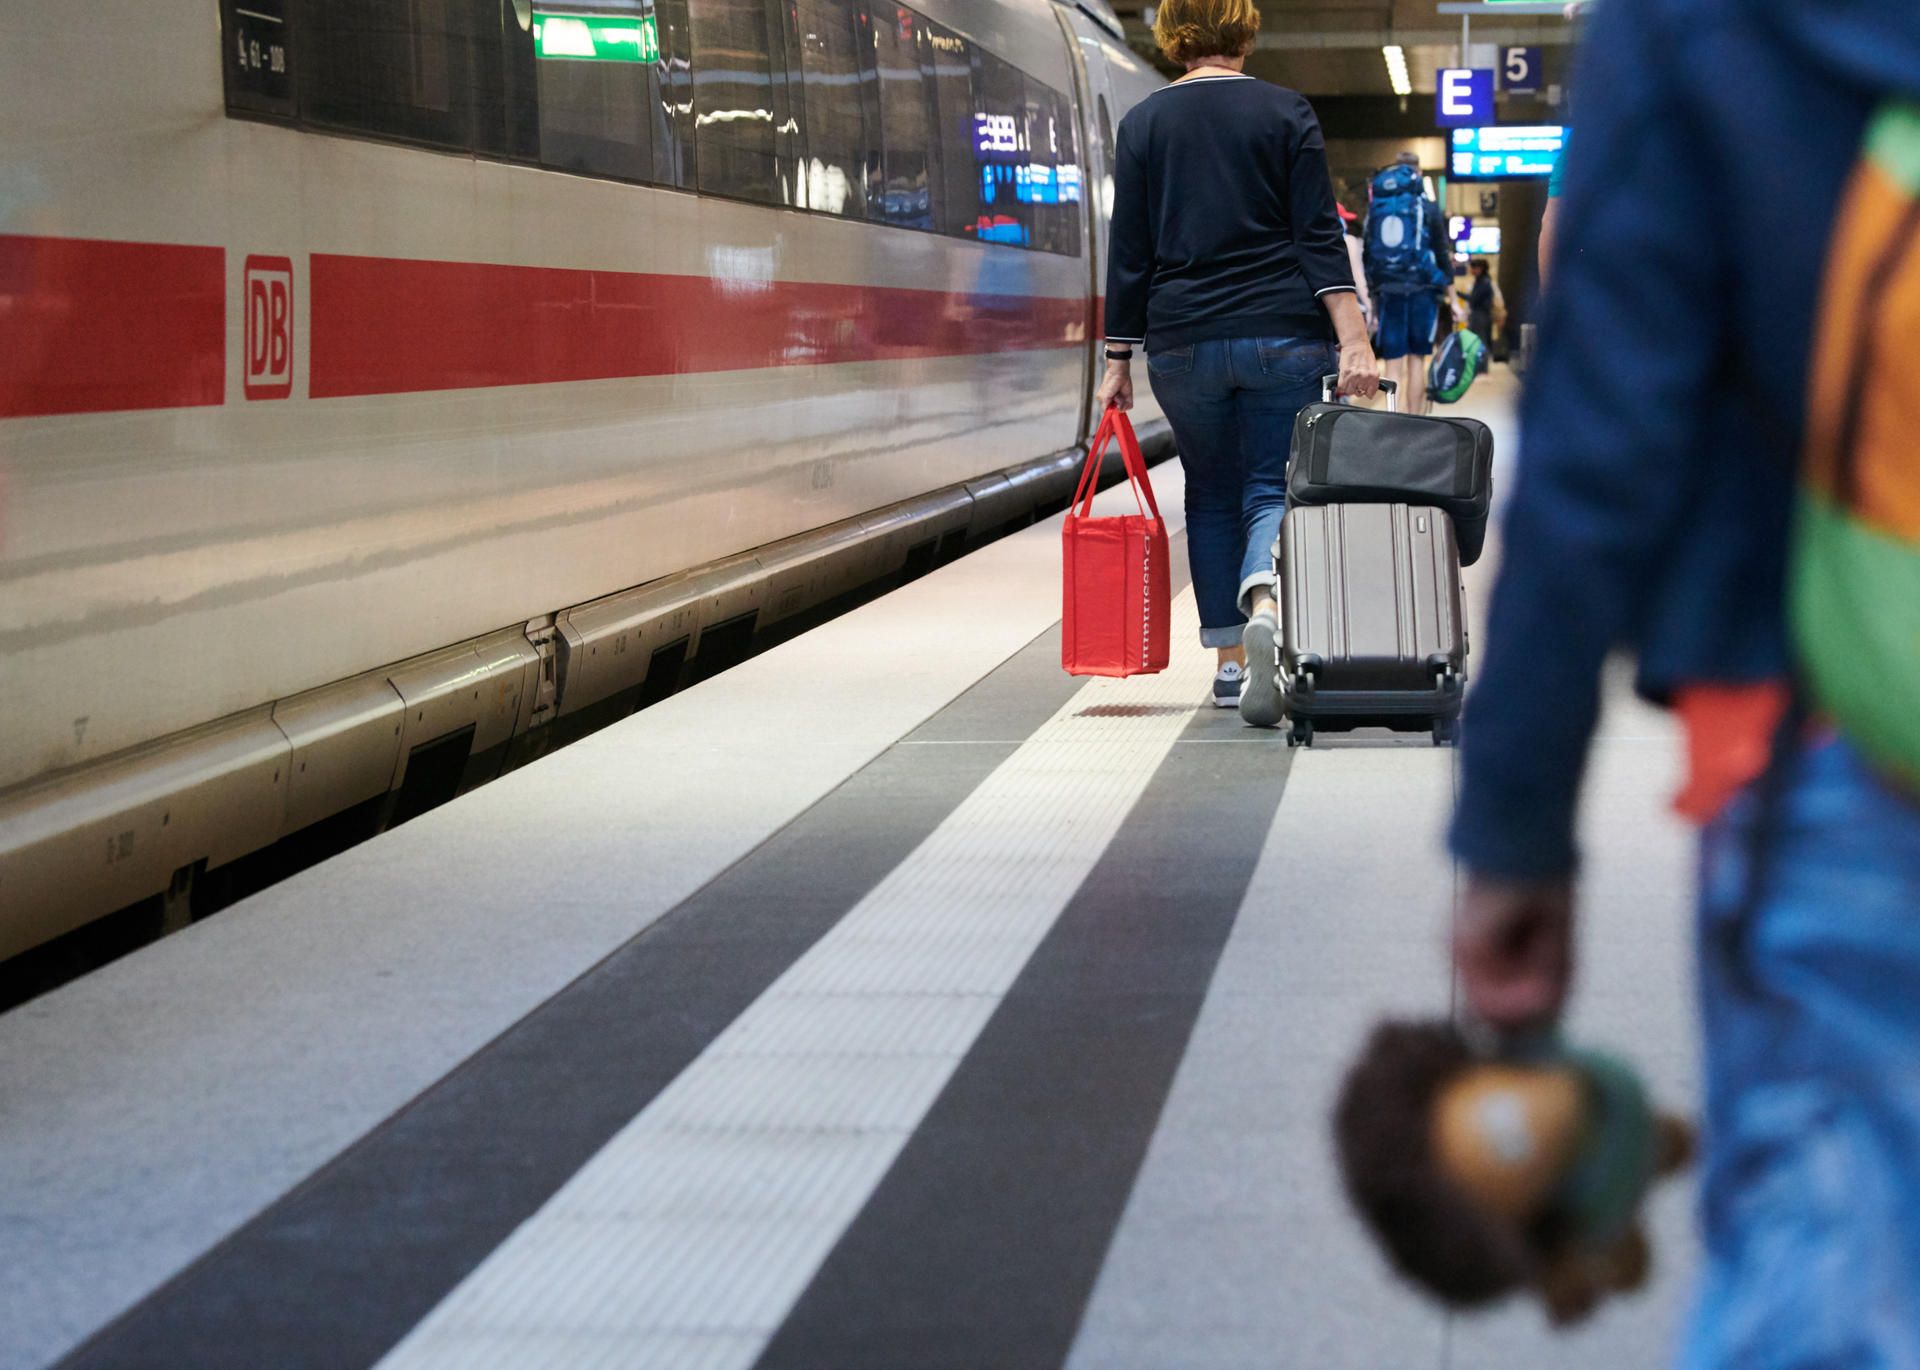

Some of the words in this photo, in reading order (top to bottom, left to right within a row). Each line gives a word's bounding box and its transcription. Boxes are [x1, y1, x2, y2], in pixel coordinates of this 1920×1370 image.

[1506, 48, 1528, 81] 5
[1442, 69, 1473, 115] E
[1449, 216, 1466, 240] F
[250, 278, 288, 376] DB
